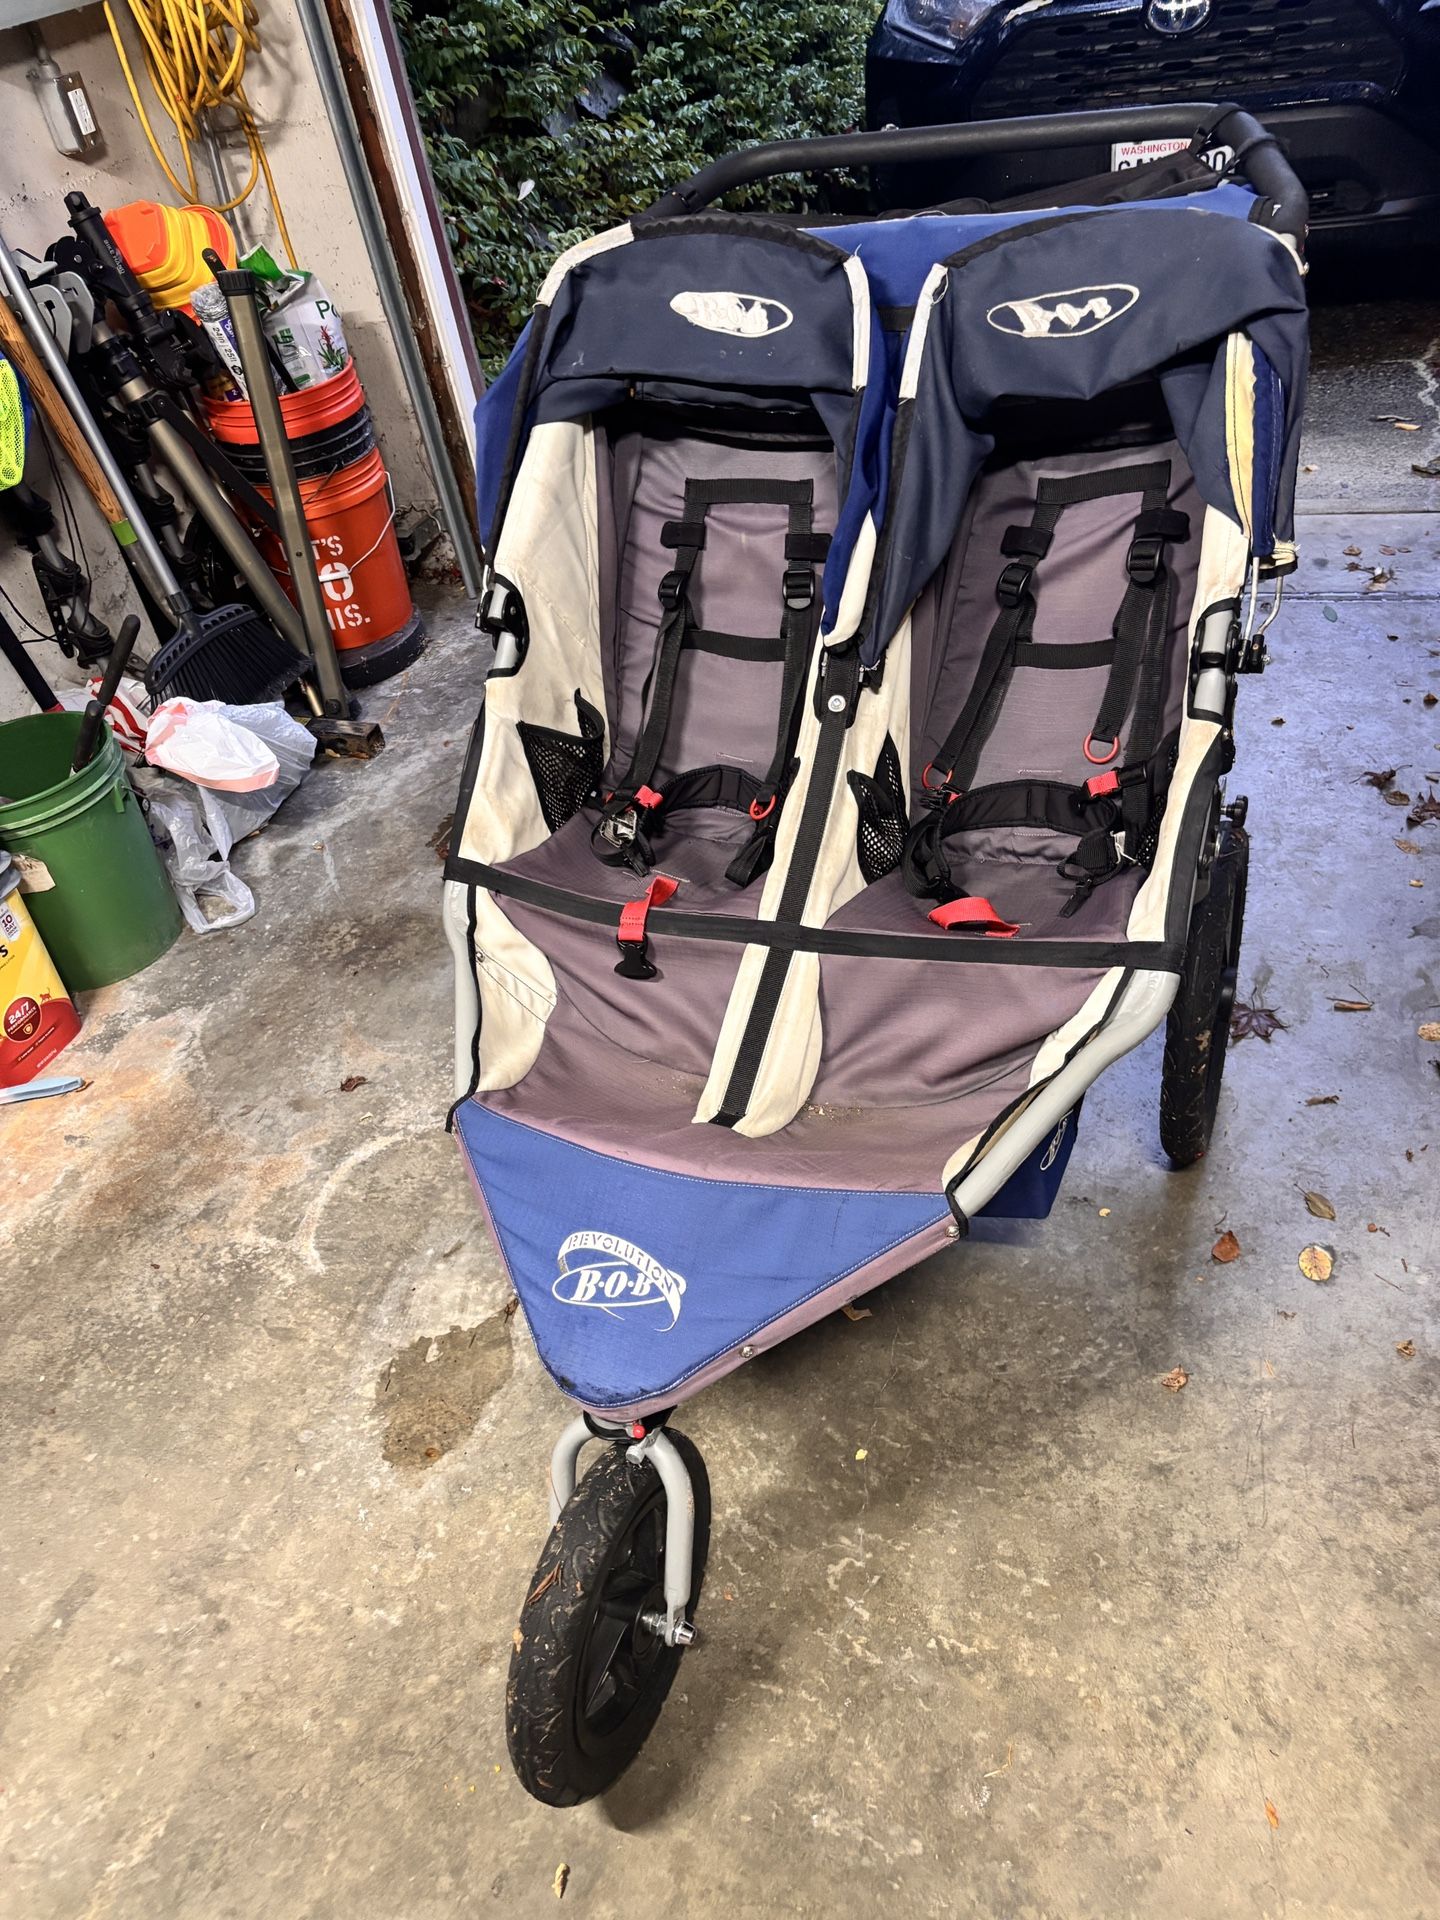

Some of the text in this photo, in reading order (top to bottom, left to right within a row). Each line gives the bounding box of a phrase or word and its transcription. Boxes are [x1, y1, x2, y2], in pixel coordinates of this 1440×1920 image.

[1121, 141, 1189, 156] WASHINGTON
[2, 914, 13, 928] 10
[7, 1006, 37, 1033] PERFORMANCE
[8, 1001, 30, 1025] 24/7
[567, 1233, 673, 1294] REVOLUTION
